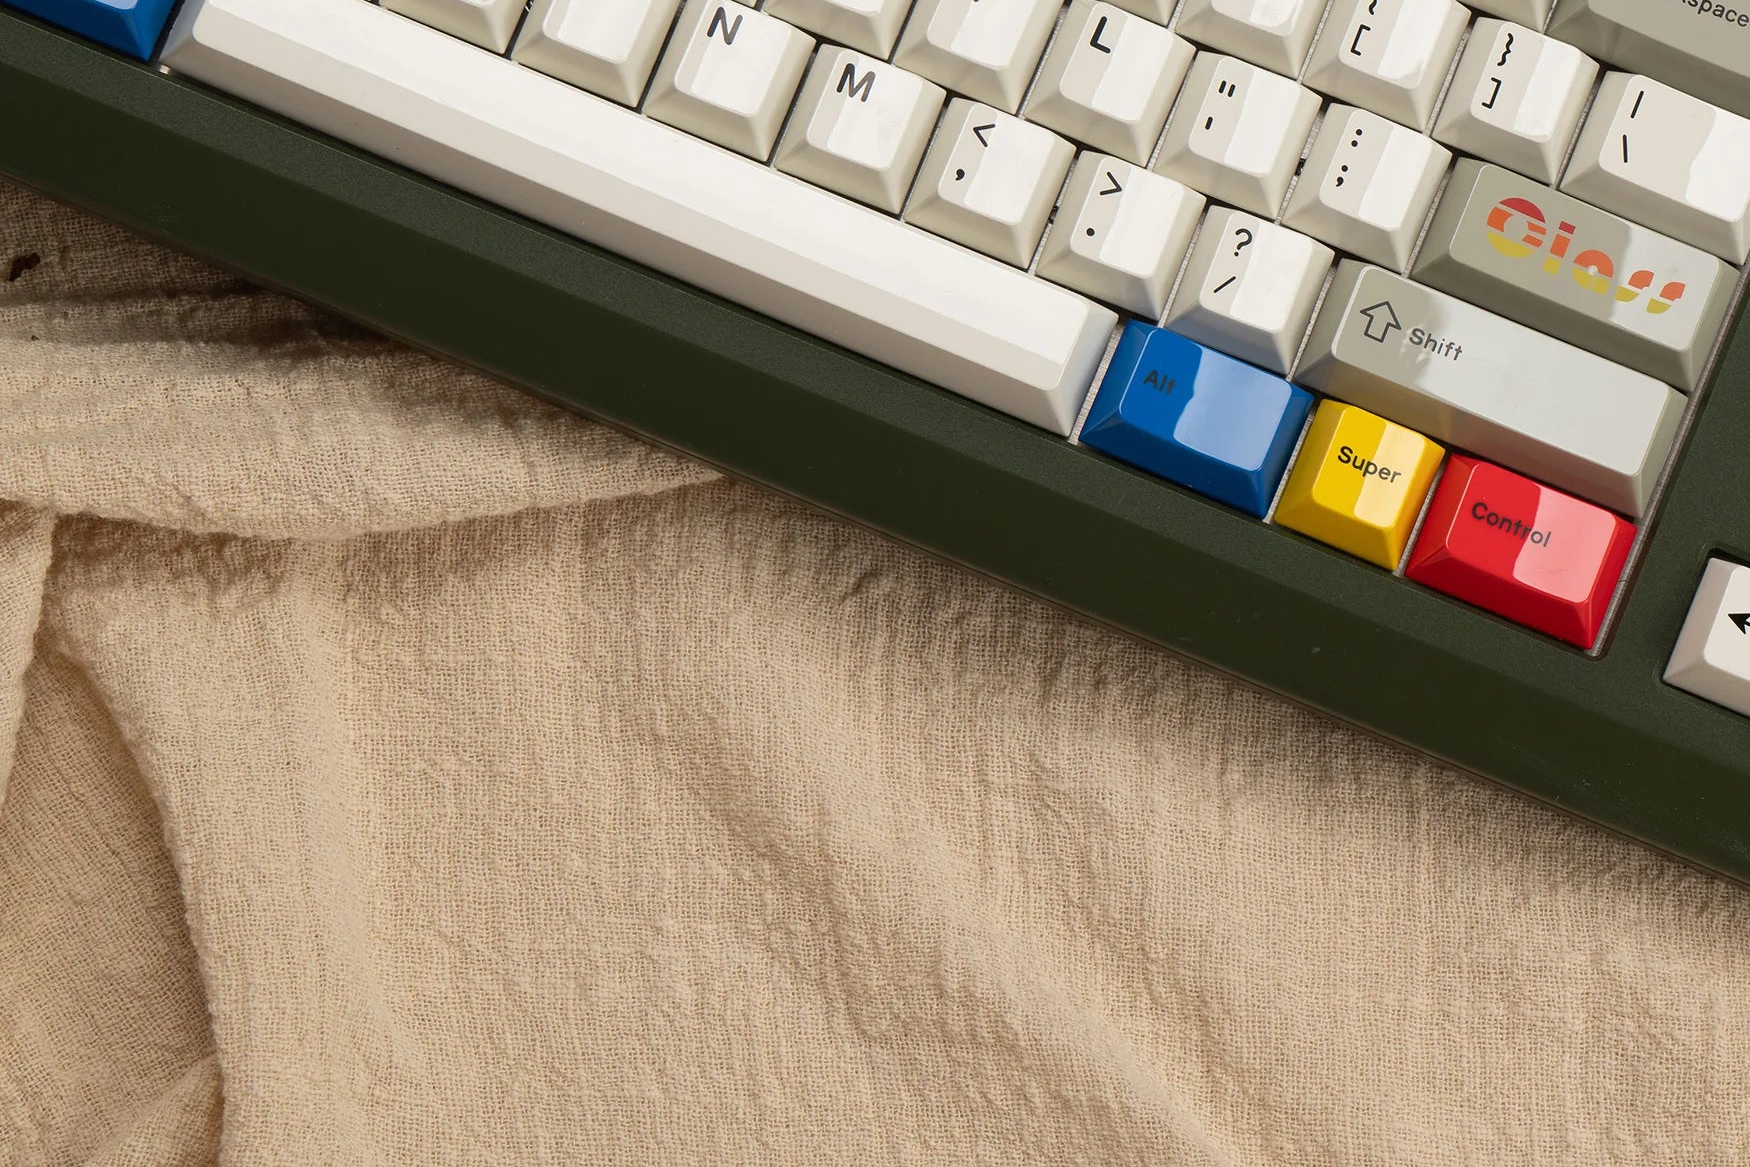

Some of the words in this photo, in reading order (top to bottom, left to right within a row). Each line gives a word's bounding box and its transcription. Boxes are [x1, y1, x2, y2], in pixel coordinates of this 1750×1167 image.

[707, 7, 743, 45] N
[1090, 16, 1111, 53] L
[1351, 24, 1371, 56] [
[1497, 33, 1513, 66] }
[836, 63, 875, 102] M
[1482, 77, 1501, 109] ]
[973, 124, 995, 147] <
[1100, 172, 1122, 195] >
[1234, 228, 1252, 256] ?
[1409, 328, 1462, 360] Shift
[1144, 370, 1175, 394] Alt
[1338, 446, 1401, 483] Super
[1472, 502, 1551, 547] Control
